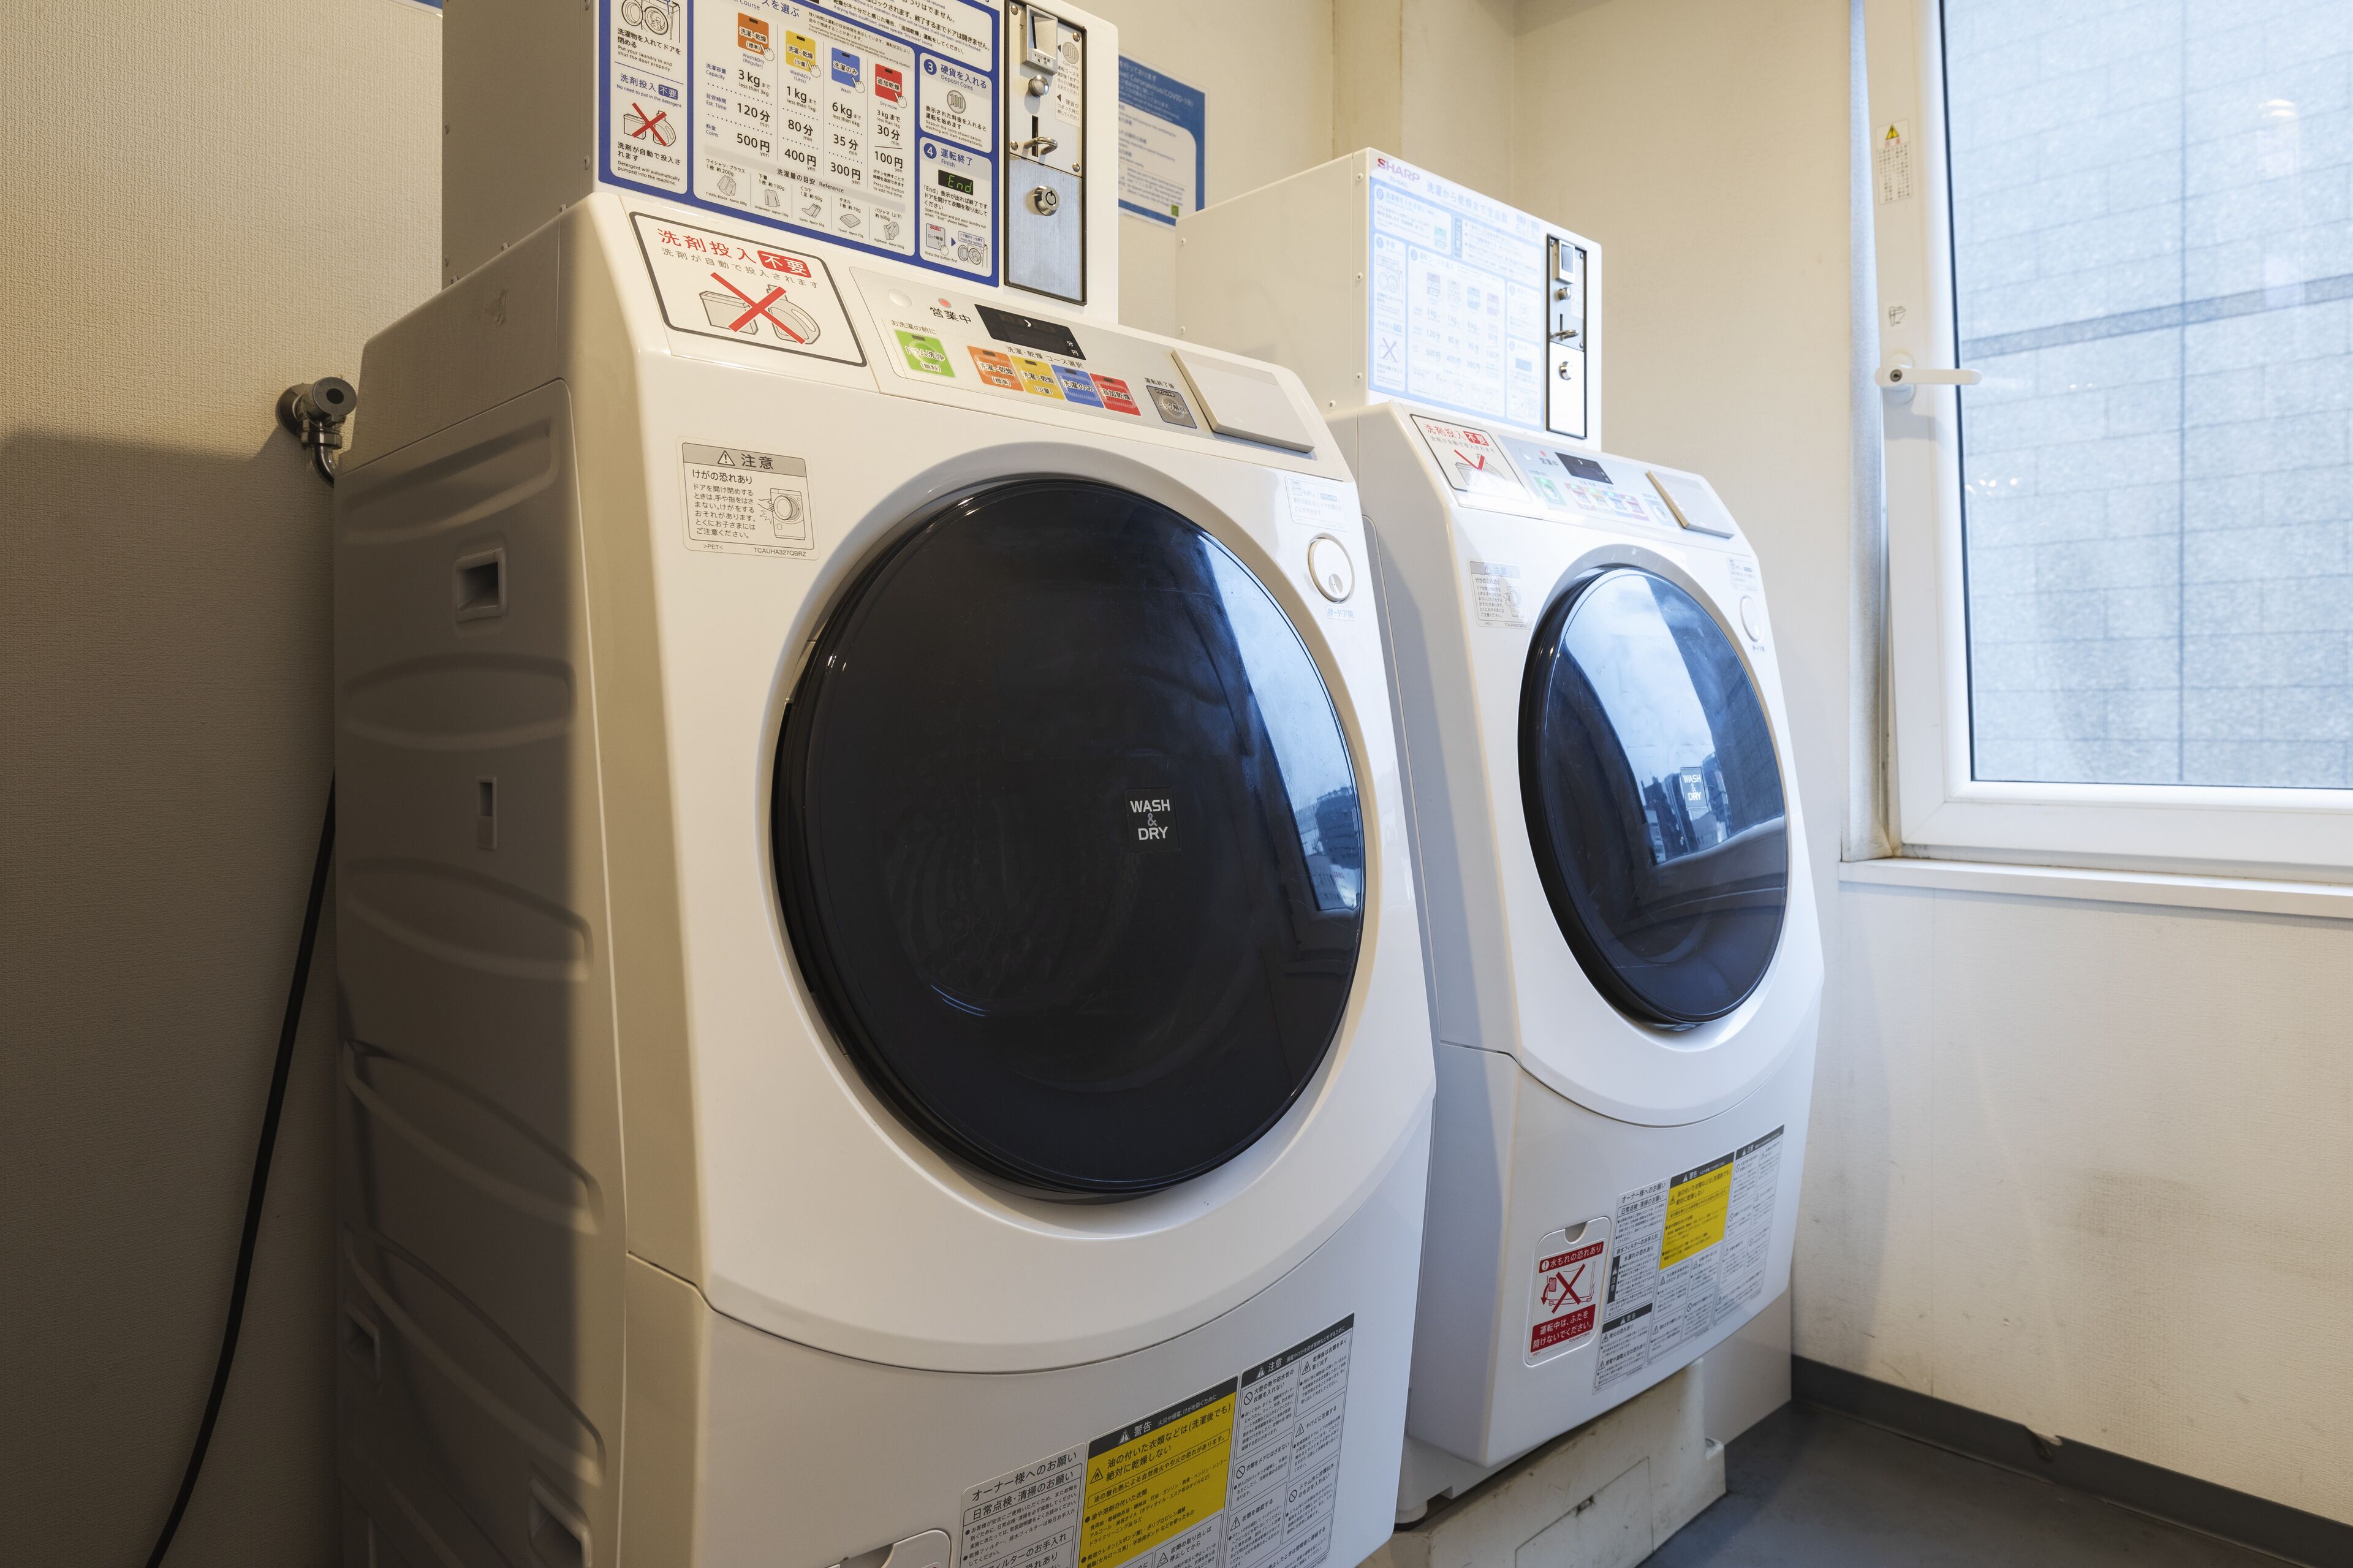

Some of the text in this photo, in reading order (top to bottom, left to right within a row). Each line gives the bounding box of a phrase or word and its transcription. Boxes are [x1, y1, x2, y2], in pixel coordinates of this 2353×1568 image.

[740, 0, 760, 10] Course
[618, 28, 681, 55] 洗濯物を入れてドアを
[618, 37, 637, 48] 閉める
[639, 50, 657, 62] laundry
[1065, 45, 1076, 60] 100
[651, 62, 671, 72] properly.
[706, 63, 726, 74] 洗濯容量
[743, 59, 763, 69] (Regular)
[834, 62, 857, 75] 洗濯のみ
[706, 70, 725, 80] Capacity
[927, 62, 987, 89] 3 硬貨を入れる
[941, 75, 973, 91] Deposit Coins
[621, 74, 677, 99] 洗剤投入 不要
[877, 76, 900, 91] 追加乾燥
[707, 93, 726, 104] 目安時間
[1066, 99, 1078, 108] 硬貨が
[926, 105, 987, 132] 表示された料金を入れると
[926, 113, 961, 130] 運転を始めます
[1058, 110, 1079, 121] 押してください
[706, 129, 719, 138] Coins
[618, 142, 681, 165] 洗剤が自動で投入さ
[618, 151, 638, 161] れます
[927, 146, 973, 165] 4 運転終了
[618, 161, 640, 170] Detergent
[651, 170, 680, 181] automatically
[941, 159, 955, 168] Finish
[1377, 158, 1420, 181] SHARP
[776, 168, 844, 193] 洗濯量の目安 Reference
[948, 175, 973, 194] End
[925, 192, 988, 217] ドアを開けて衣類を取り出して
[657, 228, 808, 275] 洗剤投入 不要
[661, 246, 819, 289] 洗剤が自動で投入されます
[930, 306, 971, 324] 営業中
[891, 320, 936, 335] お洗濯の前に
[1046, 355, 1083, 369] コース選択
[1062, 379, 1093, 392] 洗濯のみ
[1144, 377, 1175, 389] 運転終了後
[741, 453, 773, 469] 注意
[692, 469, 752, 485] けがの恐れあり
[694, 483, 753, 496] ドアを開け閉めする
[694, 493, 754, 505] ときは、手や指をはさ
[694, 501, 754, 513] まない。けがをする
[695, 510, 756, 522] おそれがあります。
[695, 519, 756, 530] とくにお子さまには
[696, 528, 749, 539] ご注意ください。
[1683, 774, 1701, 783] WASH
[1691, 783, 1696, 792] &
[1688, 792, 1701, 801] DRY
[1130, 799, 1170, 812] WASH
[1147, 812, 1158, 827] &
[1138, 827, 1168, 841] DRY
[1622, 1182, 1666, 1203] オーナー様へのお願い
[1550, 1244, 1602, 1269] 水もれの恐れあり
[1540, 1310, 1588, 1335] 運転中は、ふたを
[1533, 1322, 1592, 1348] 開けないでください。
[1268, 1358, 1282, 1373] 注意
[1312, 1357, 1328, 1370] 取り出す
[1253, 1382, 1285, 1403] 衣類を入れない
[1306, 1406, 1337, 1428] やけどに注意する
[1108, 1403, 1231, 1469] 油の付いた衣類などは(洗濯後でも)
[1134, 1421, 1152, 1437] 警告
[1106, 1445, 1172, 1482] 絶対に乾燥しない
[1246, 1442, 1289, 1471] 衣類をドアにはさまない
[972, 1452, 1077, 1501] オーナー様へのお願い
[1094, 1434, 1225, 1503] 油の酸化熱による自然発火や引火の恐れがあります。
[1298, 1474, 1330, 1498] のものを入れない
[973, 1471, 1074, 1520] 日常点検・清掃のお願い
[1091, 1488, 1147, 1520] 油や溶剤の付いた衣類
[1242, 1499, 1273, 1522] 衣類を確認する
[1170, 1526, 1211, 1554] 衣類の取り出しは
[969, 1551, 1000, 1567] してください。
[1170, 1541, 1200, 1562] 停止してから
